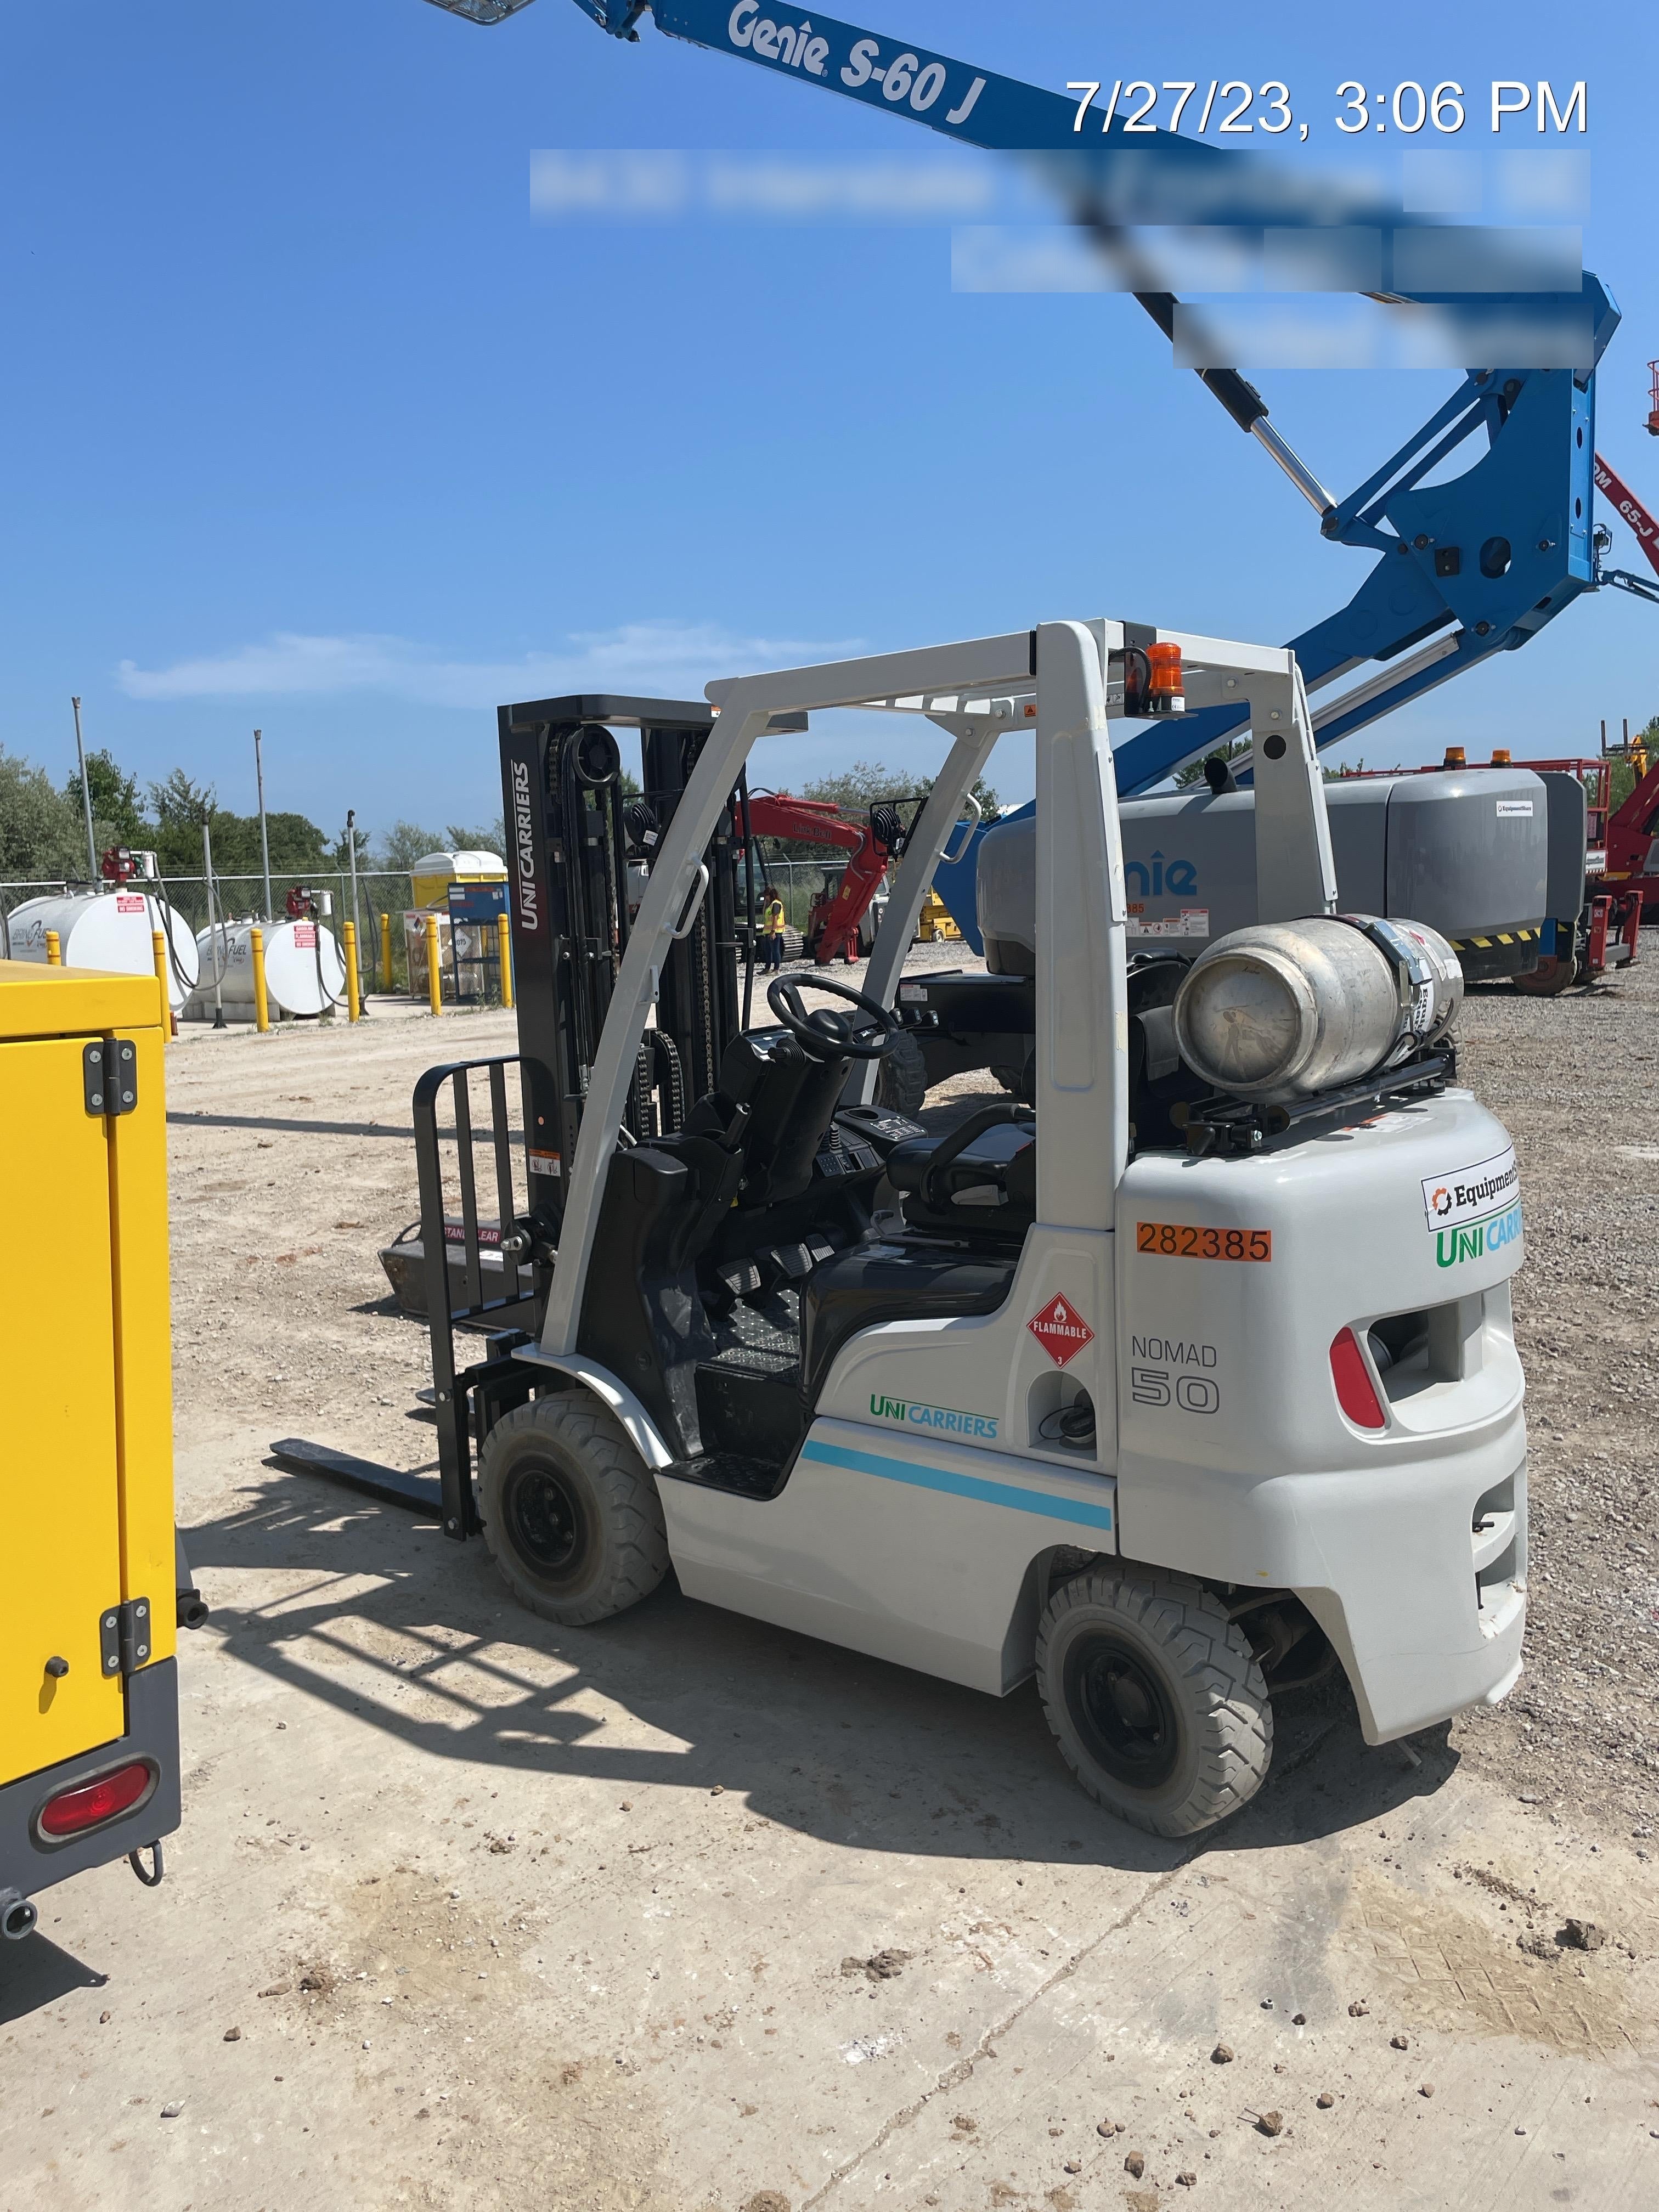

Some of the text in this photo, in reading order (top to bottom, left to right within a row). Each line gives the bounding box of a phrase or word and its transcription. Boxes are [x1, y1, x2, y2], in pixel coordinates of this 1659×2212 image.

[729, 0, 986, 124] Genie S-60 J
[1620, 500, 1654, 537] 65-J
[511, 759, 538, 930] UNICARRIERS
[1125, 850, 1197, 896] nie
[1139, 1223, 1269, 1260] 282385
[1034, 1321, 1087, 1339] FLAMMABLE
[1058, 1356, 1063, 1365] 3
[1132, 1335, 1217, 1368] NOMAD
[1131, 1367, 1220, 1414] 50
[870, 1393, 999, 1439] UNICARRIERS
